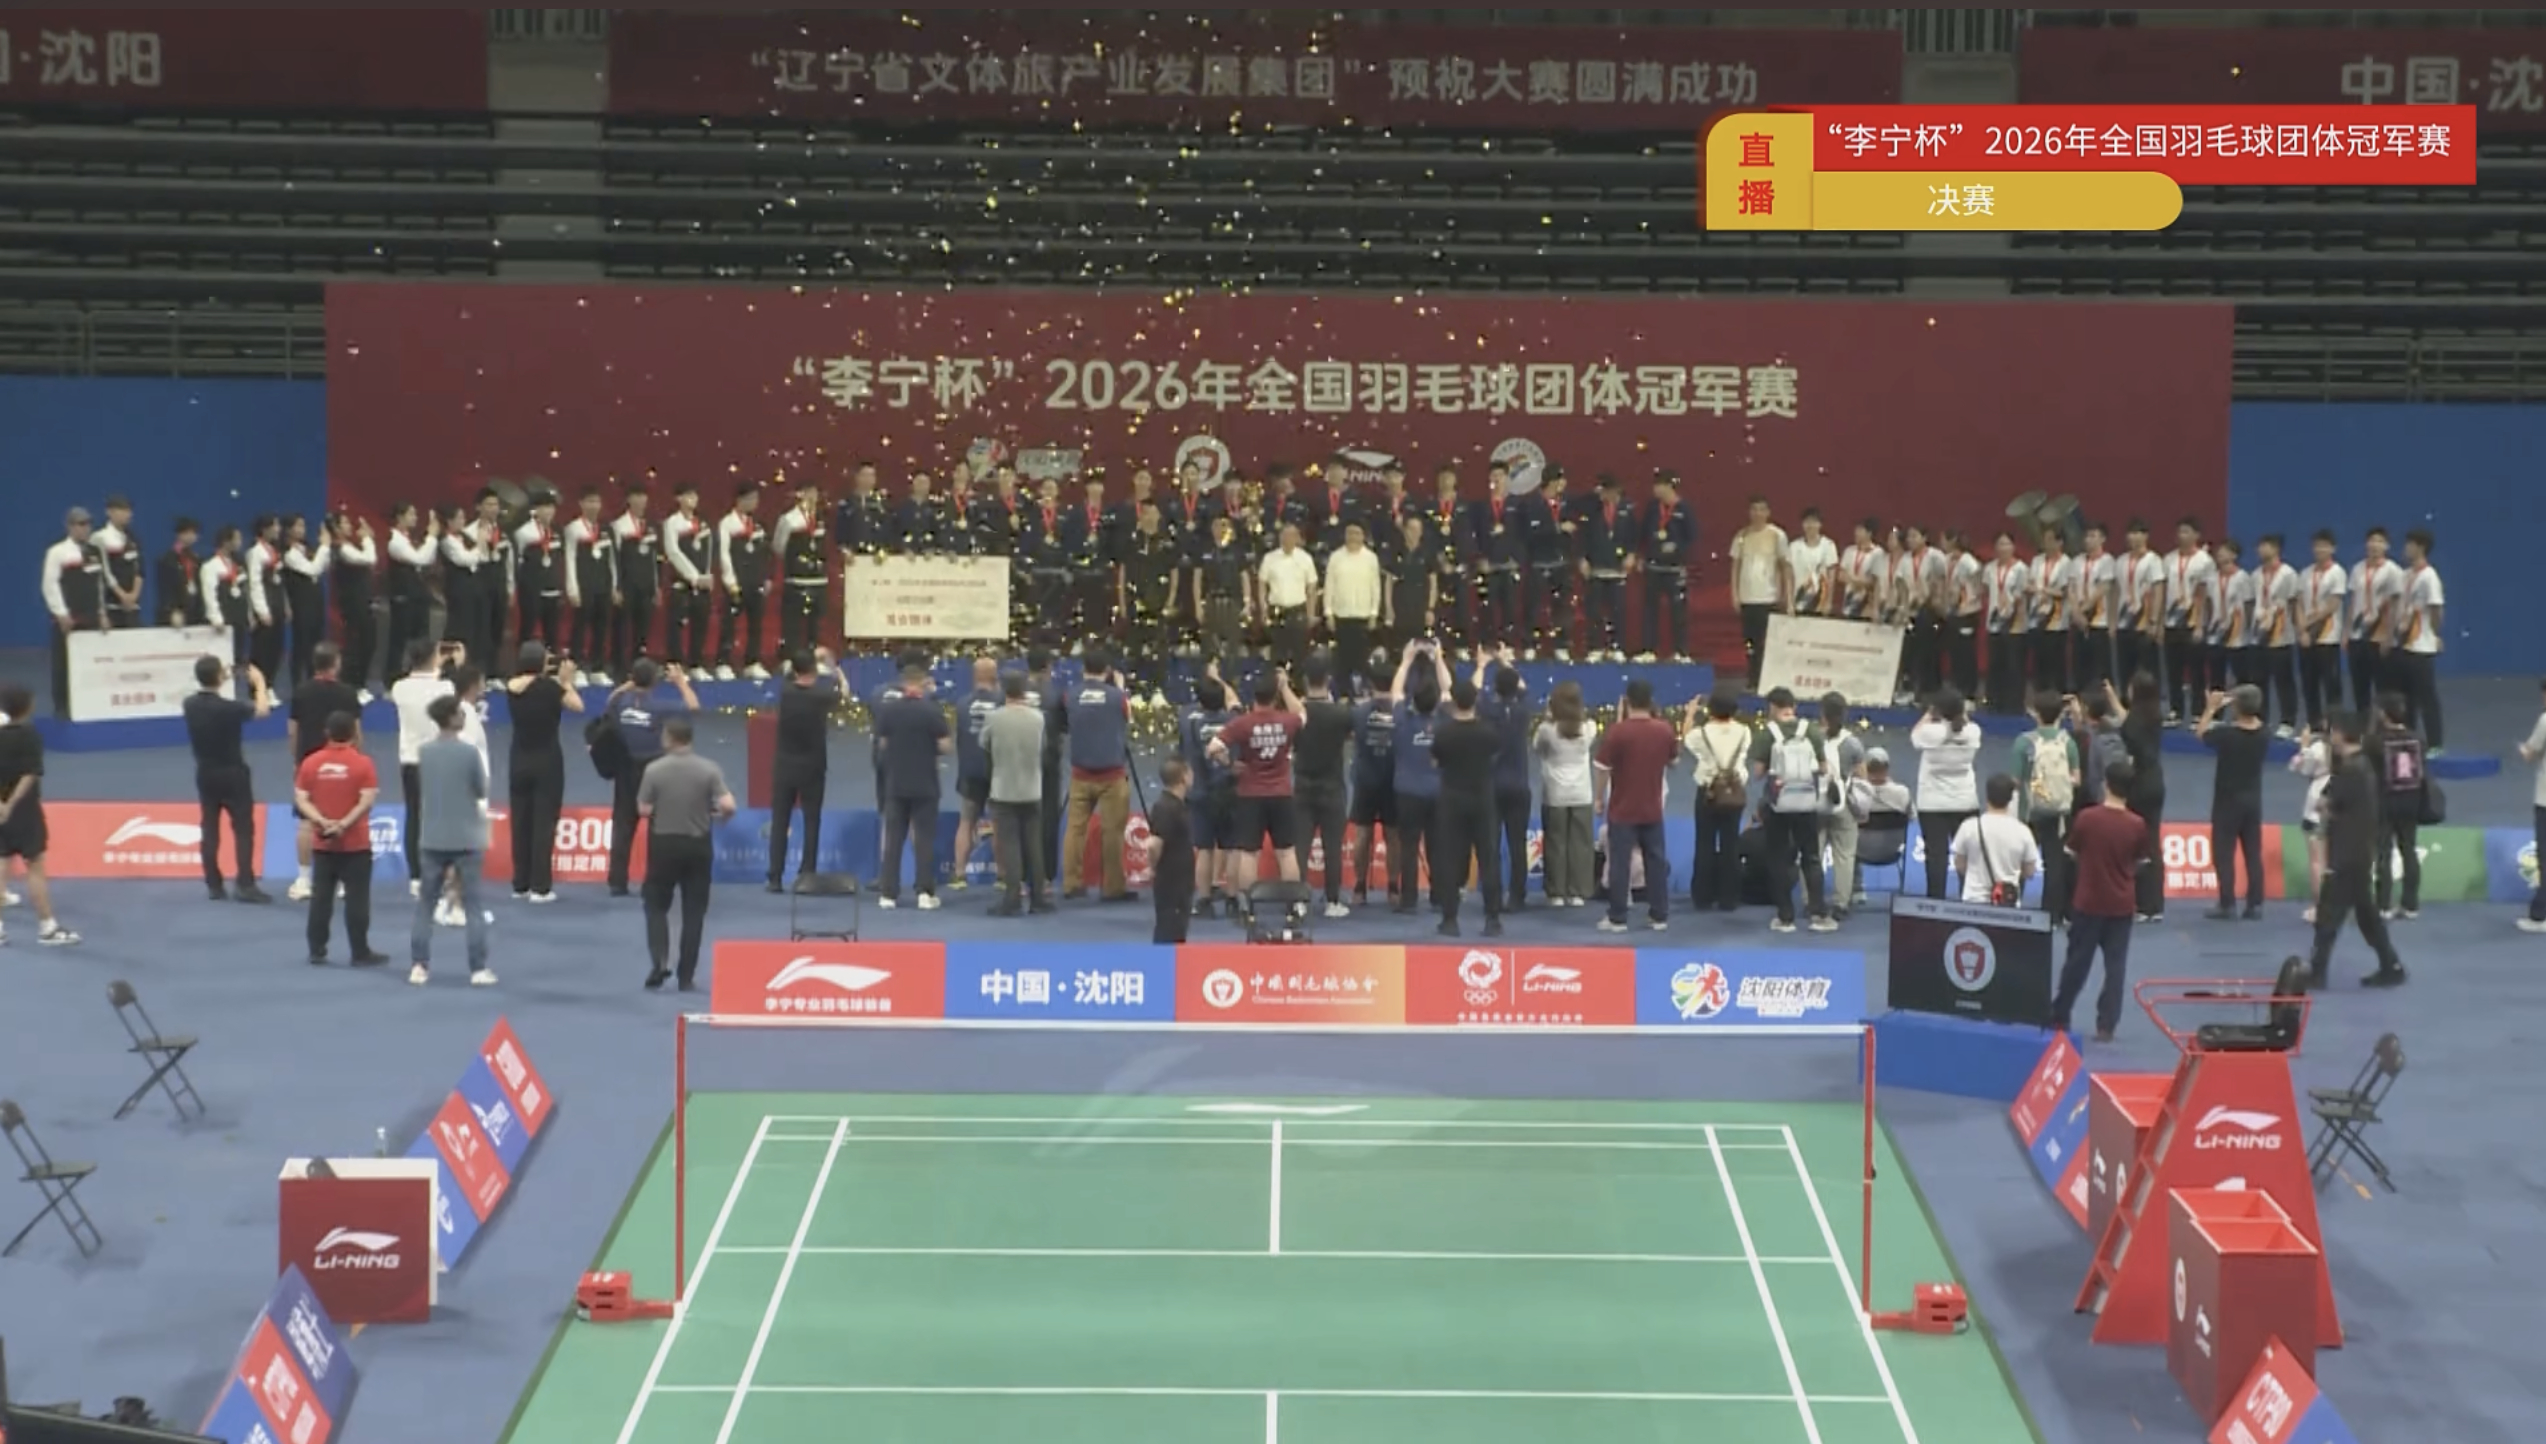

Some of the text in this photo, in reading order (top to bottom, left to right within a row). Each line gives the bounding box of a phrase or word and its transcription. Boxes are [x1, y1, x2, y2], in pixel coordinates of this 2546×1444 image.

[0, 28, 162, 86] ·沈阳
[981, 968, 1145, 1006] 中国·沈阳
[2194, 1133, 2282, 1150] LI-NING
[314, 1253, 401, 1270] LI-NING
